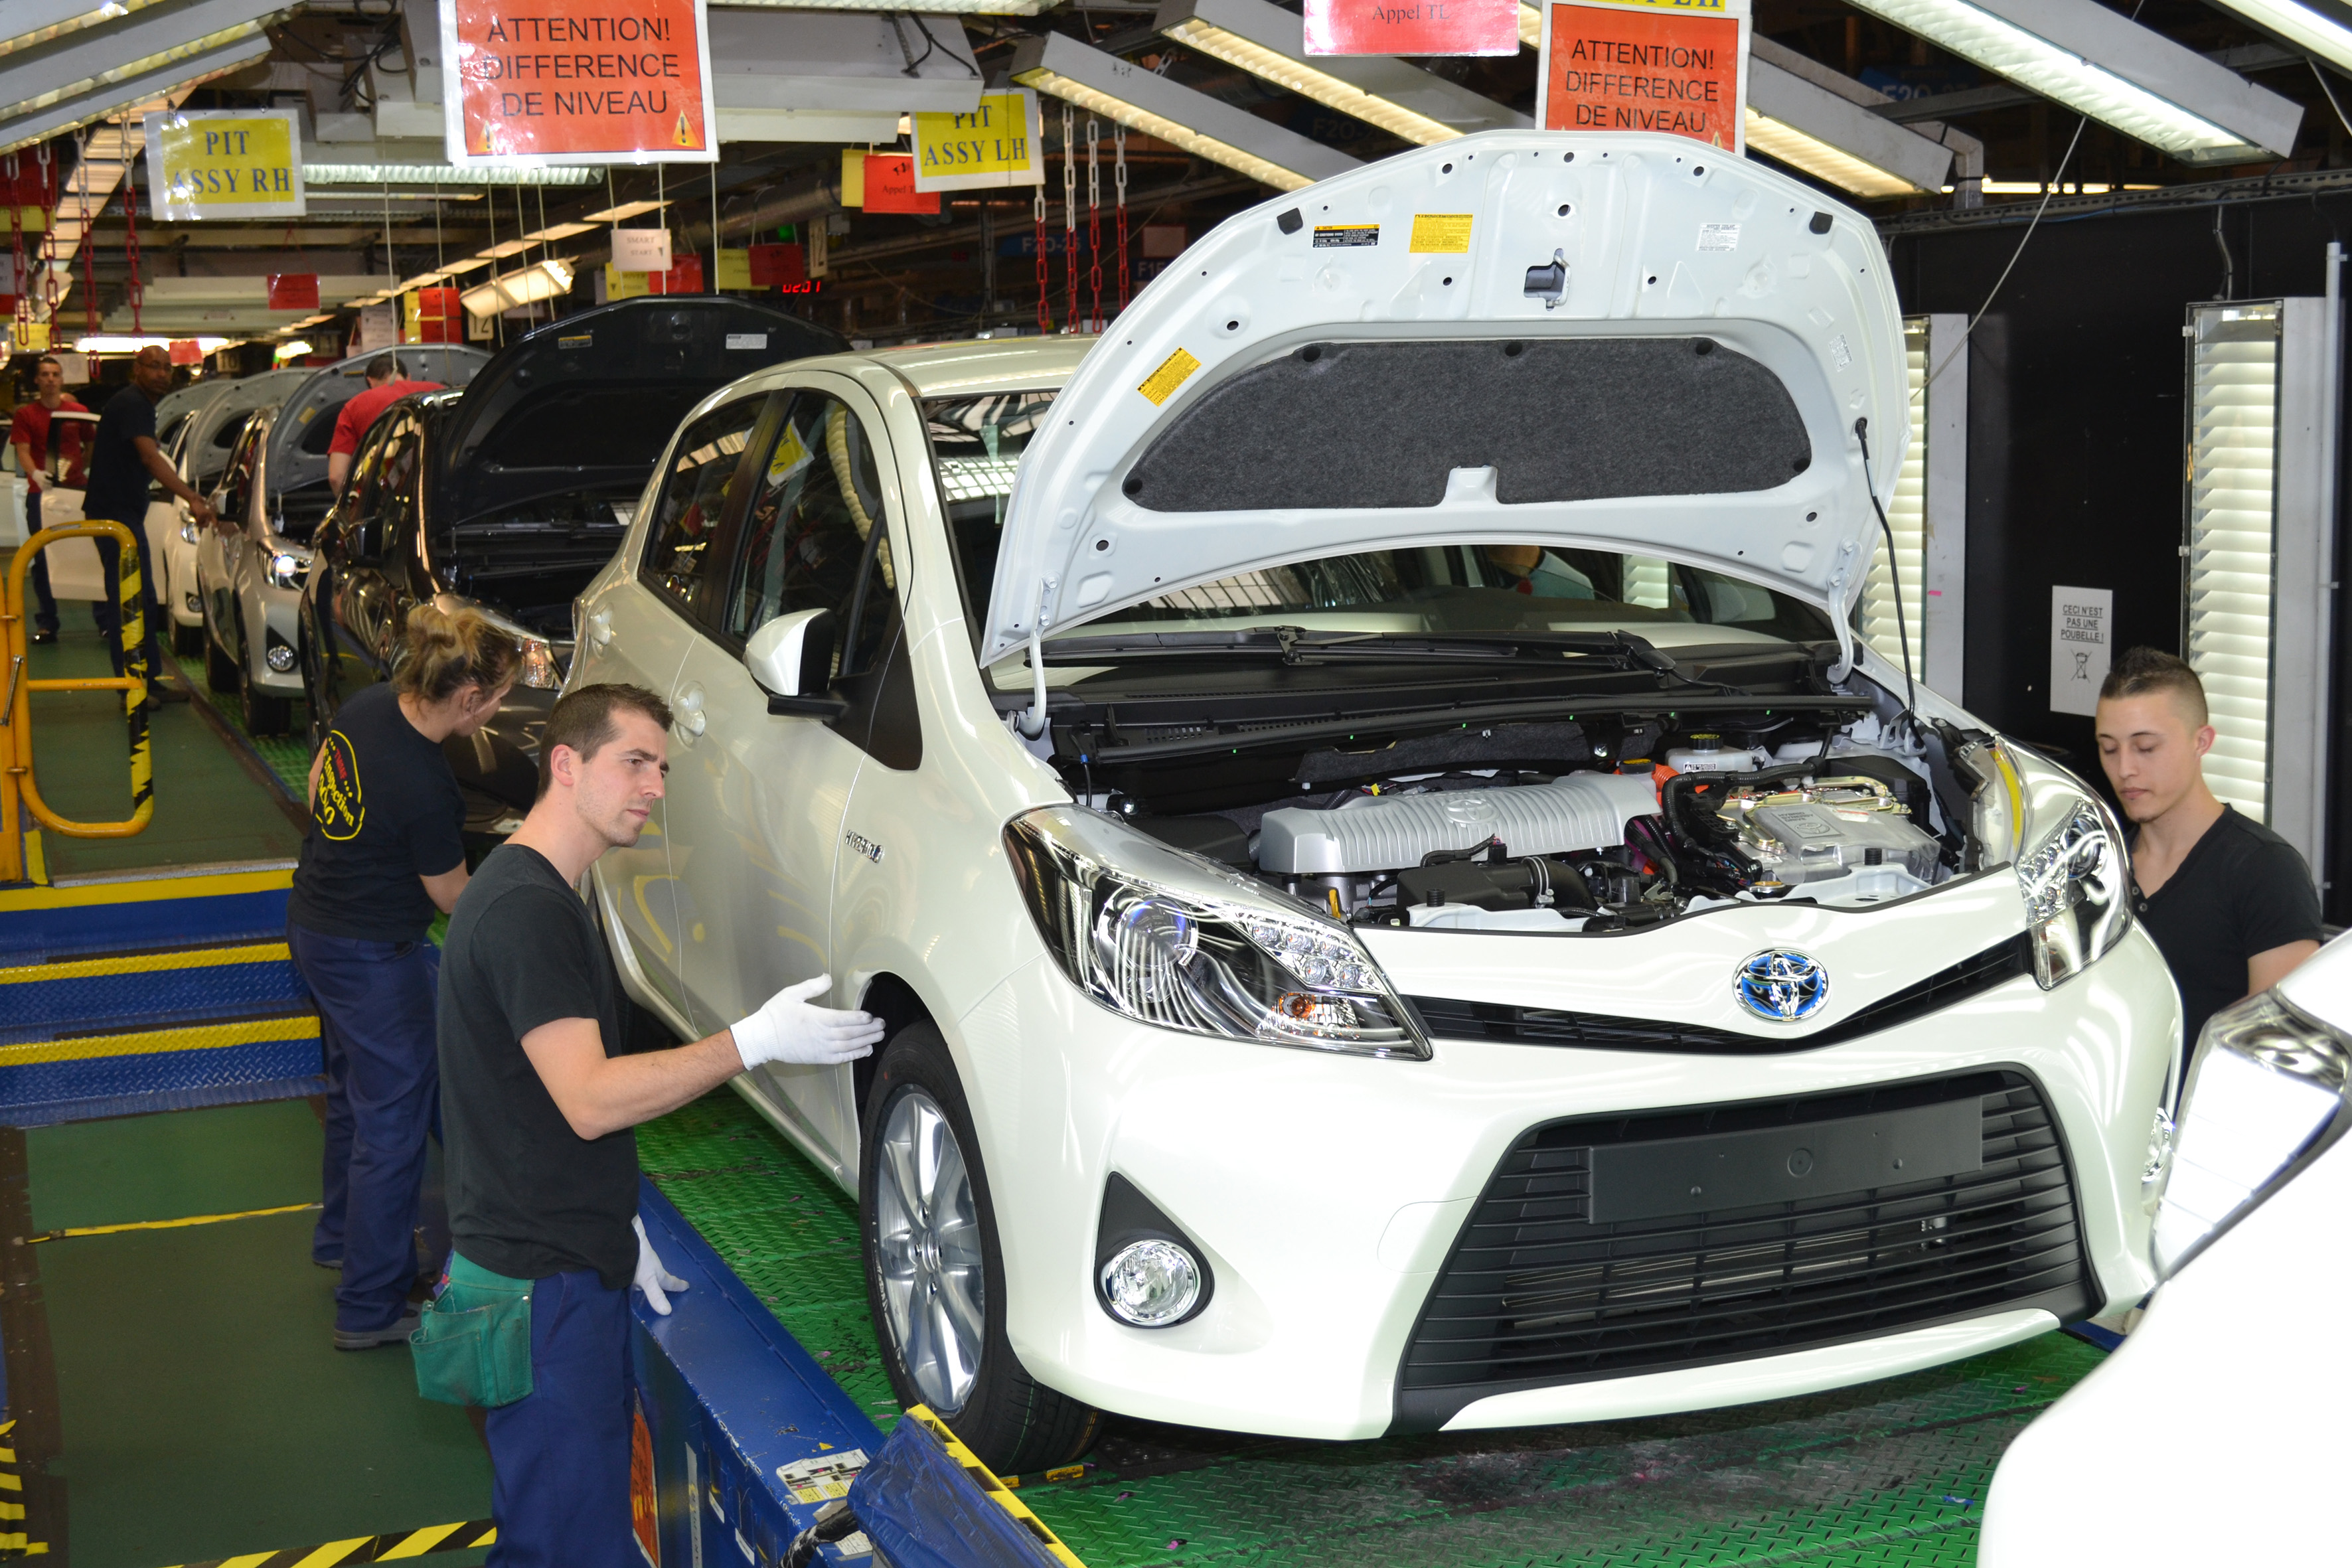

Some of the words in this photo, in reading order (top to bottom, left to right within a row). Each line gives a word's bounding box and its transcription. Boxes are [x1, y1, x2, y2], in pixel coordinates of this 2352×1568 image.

[1372, 4, 1420, 24] Appel
[1426, 4, 1450, 19] TL
[487, 18, 670, 42] ATTENTION!
[483, 53, 680, 80] DIFFERENCE
[1571, 39, 1713, 70] ATTENTION!
[1566, 70, 1718, 102] DIFFERENCE
[501, 92, 544, 117] DE
[555, 90, 667, 115] NIVEAU
[1577, 104, 1607, 126] DE
[1616, 107, 1705, 132] NIVEAU
[204, 131, 250, 155] PIT
[924, 140, 985, 166] ASSY
[994, 138, 1026, 161] LH
[171, 169, 240, 195] ASSY
[252, 168, 291, 192] RH
[883, 185, 905, 196] Appel
[2063, 604, 2080, 615] CECI
[2082, 607, 2102, 617] N'EST
[2066, 617, 2081, 627] PAS
[2083, 619, 2098, 629] UNE
[2061, 629, 2099, 642] POUBELLE
